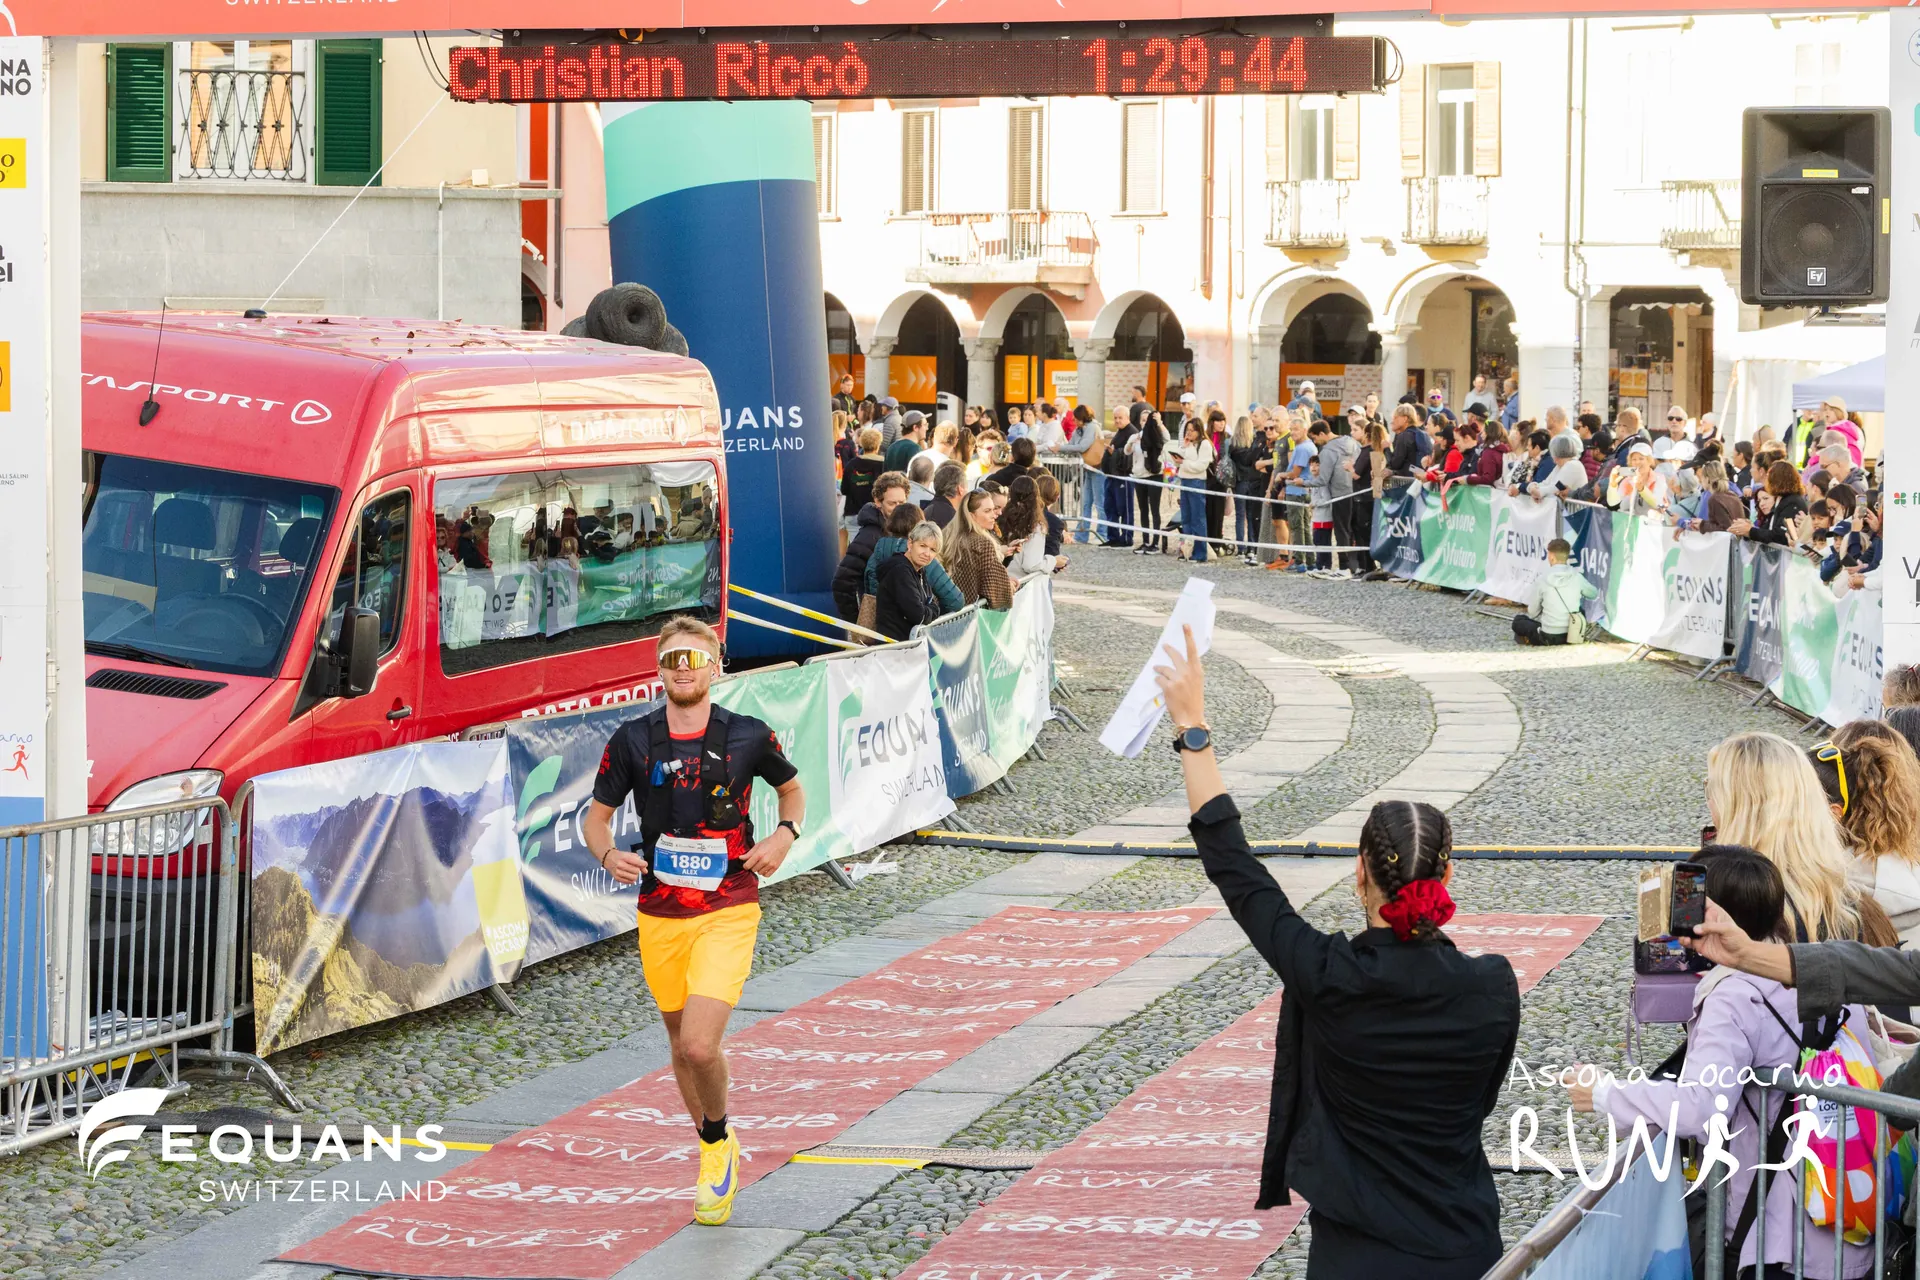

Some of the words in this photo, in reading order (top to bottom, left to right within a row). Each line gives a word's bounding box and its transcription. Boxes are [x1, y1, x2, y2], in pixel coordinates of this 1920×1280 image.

[449, 45, 685, 100] Christian
[716, 42, 869, 97] Riccò
[1083, 36, 1307, 93] 1:29:44
[671, 854, 712, 871] 1880
